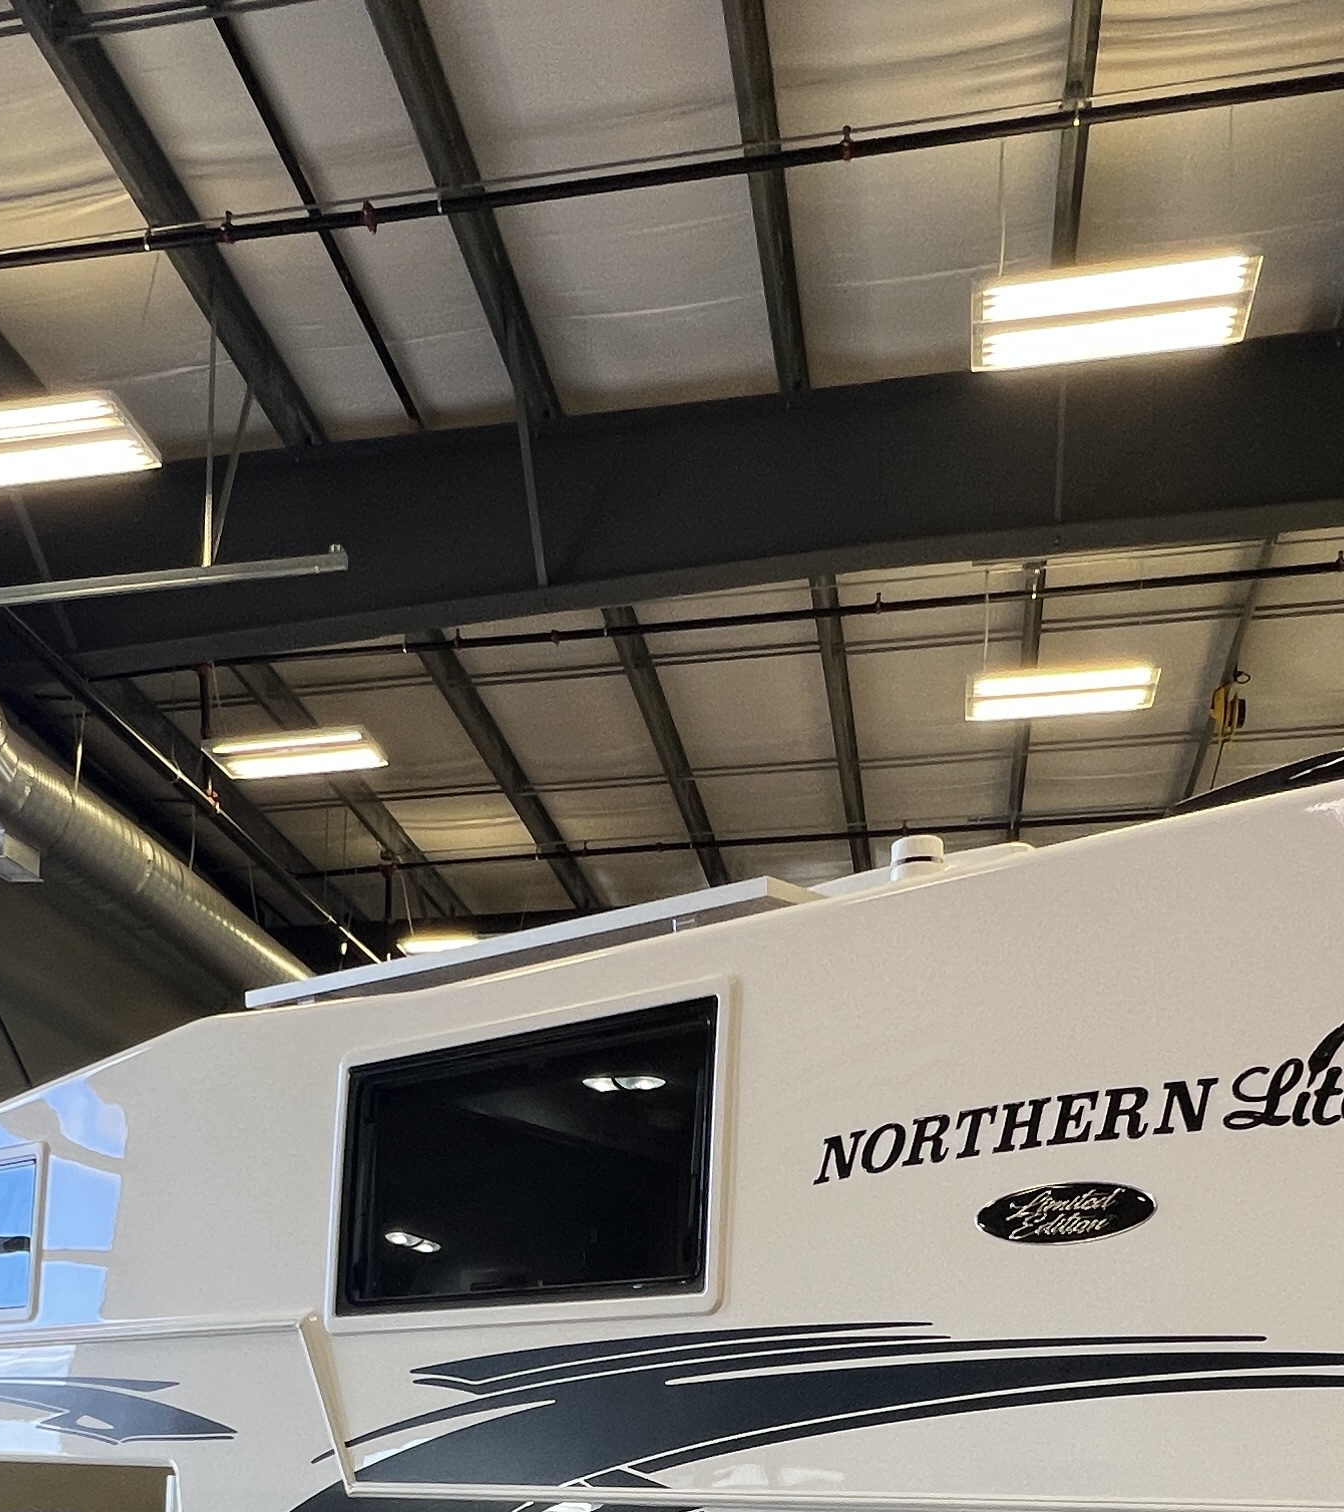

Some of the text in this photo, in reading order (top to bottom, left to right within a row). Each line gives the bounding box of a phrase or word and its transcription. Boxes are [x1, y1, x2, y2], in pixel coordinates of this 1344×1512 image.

[813, 1078, 1219, 1186] NORTHERN
[1005, 1188, 1127, 1222] Limited
[1008, 1210, 1110, 1240] Edition
